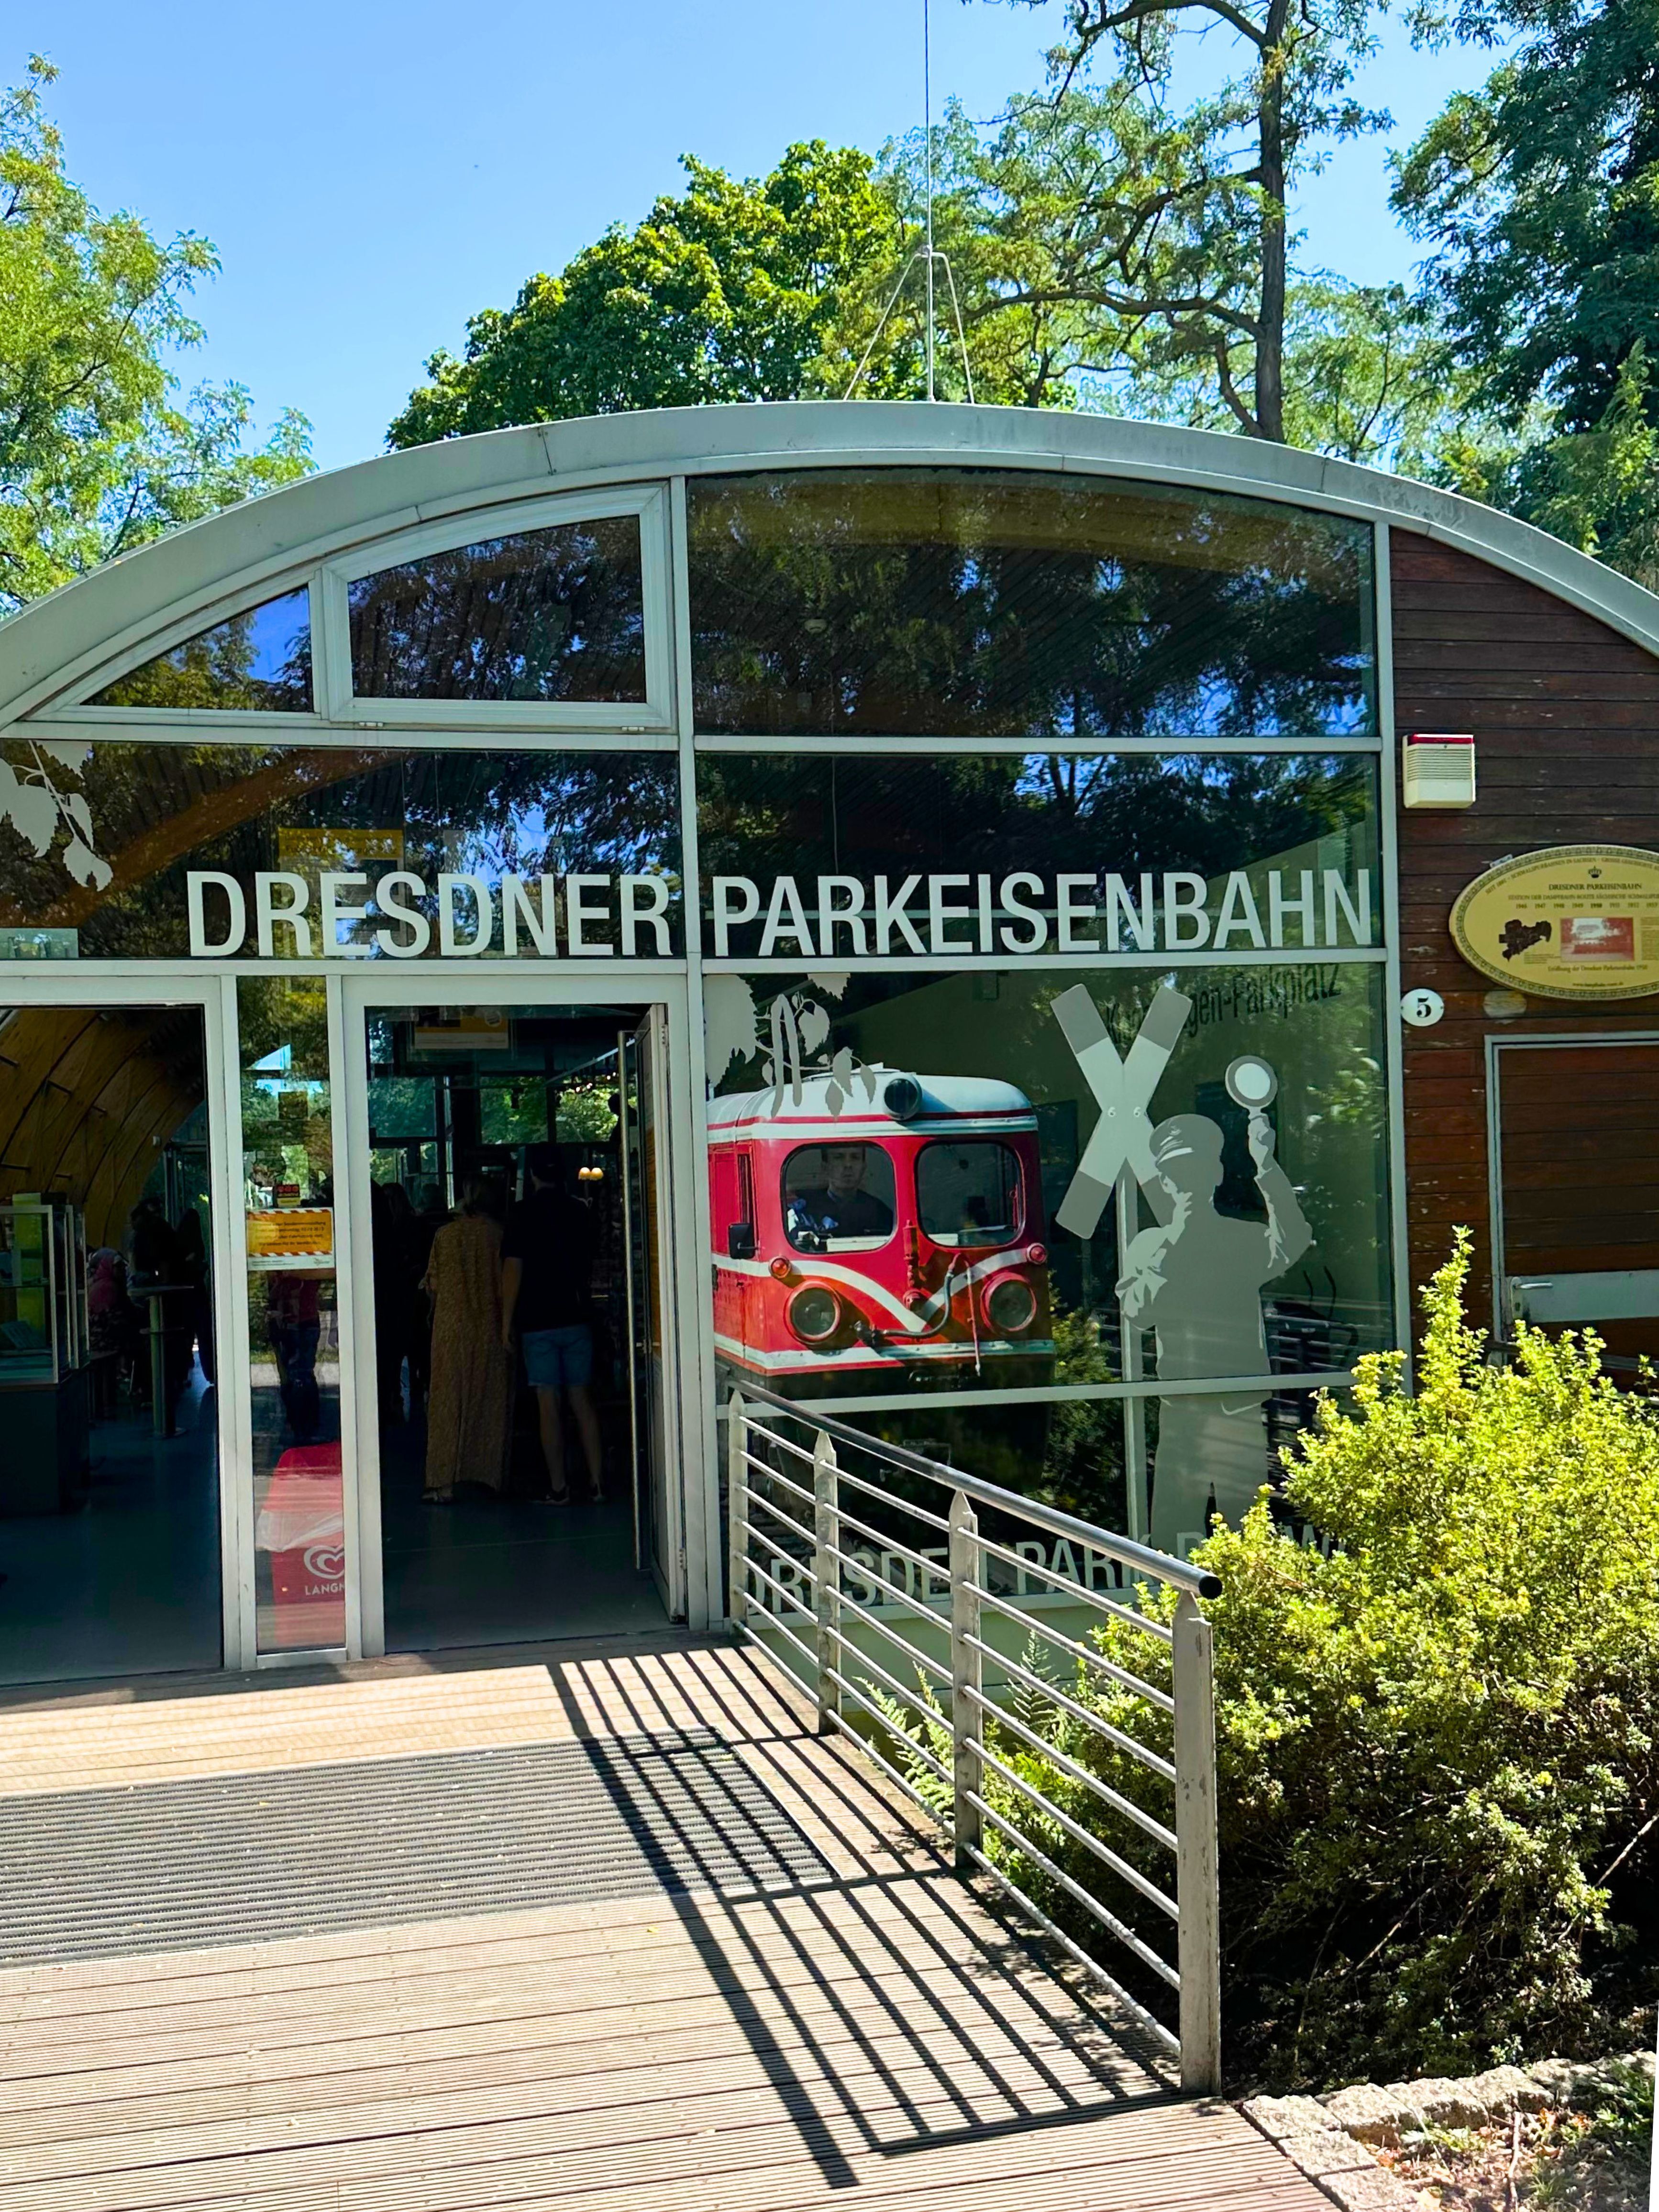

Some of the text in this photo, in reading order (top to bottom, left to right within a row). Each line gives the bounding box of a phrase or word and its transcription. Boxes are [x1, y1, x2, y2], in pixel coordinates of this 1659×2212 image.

[187, 868, 1372, 957] DRESDNER PARKEISENBAHN
[1416, 996, 1431, 1018] 5
